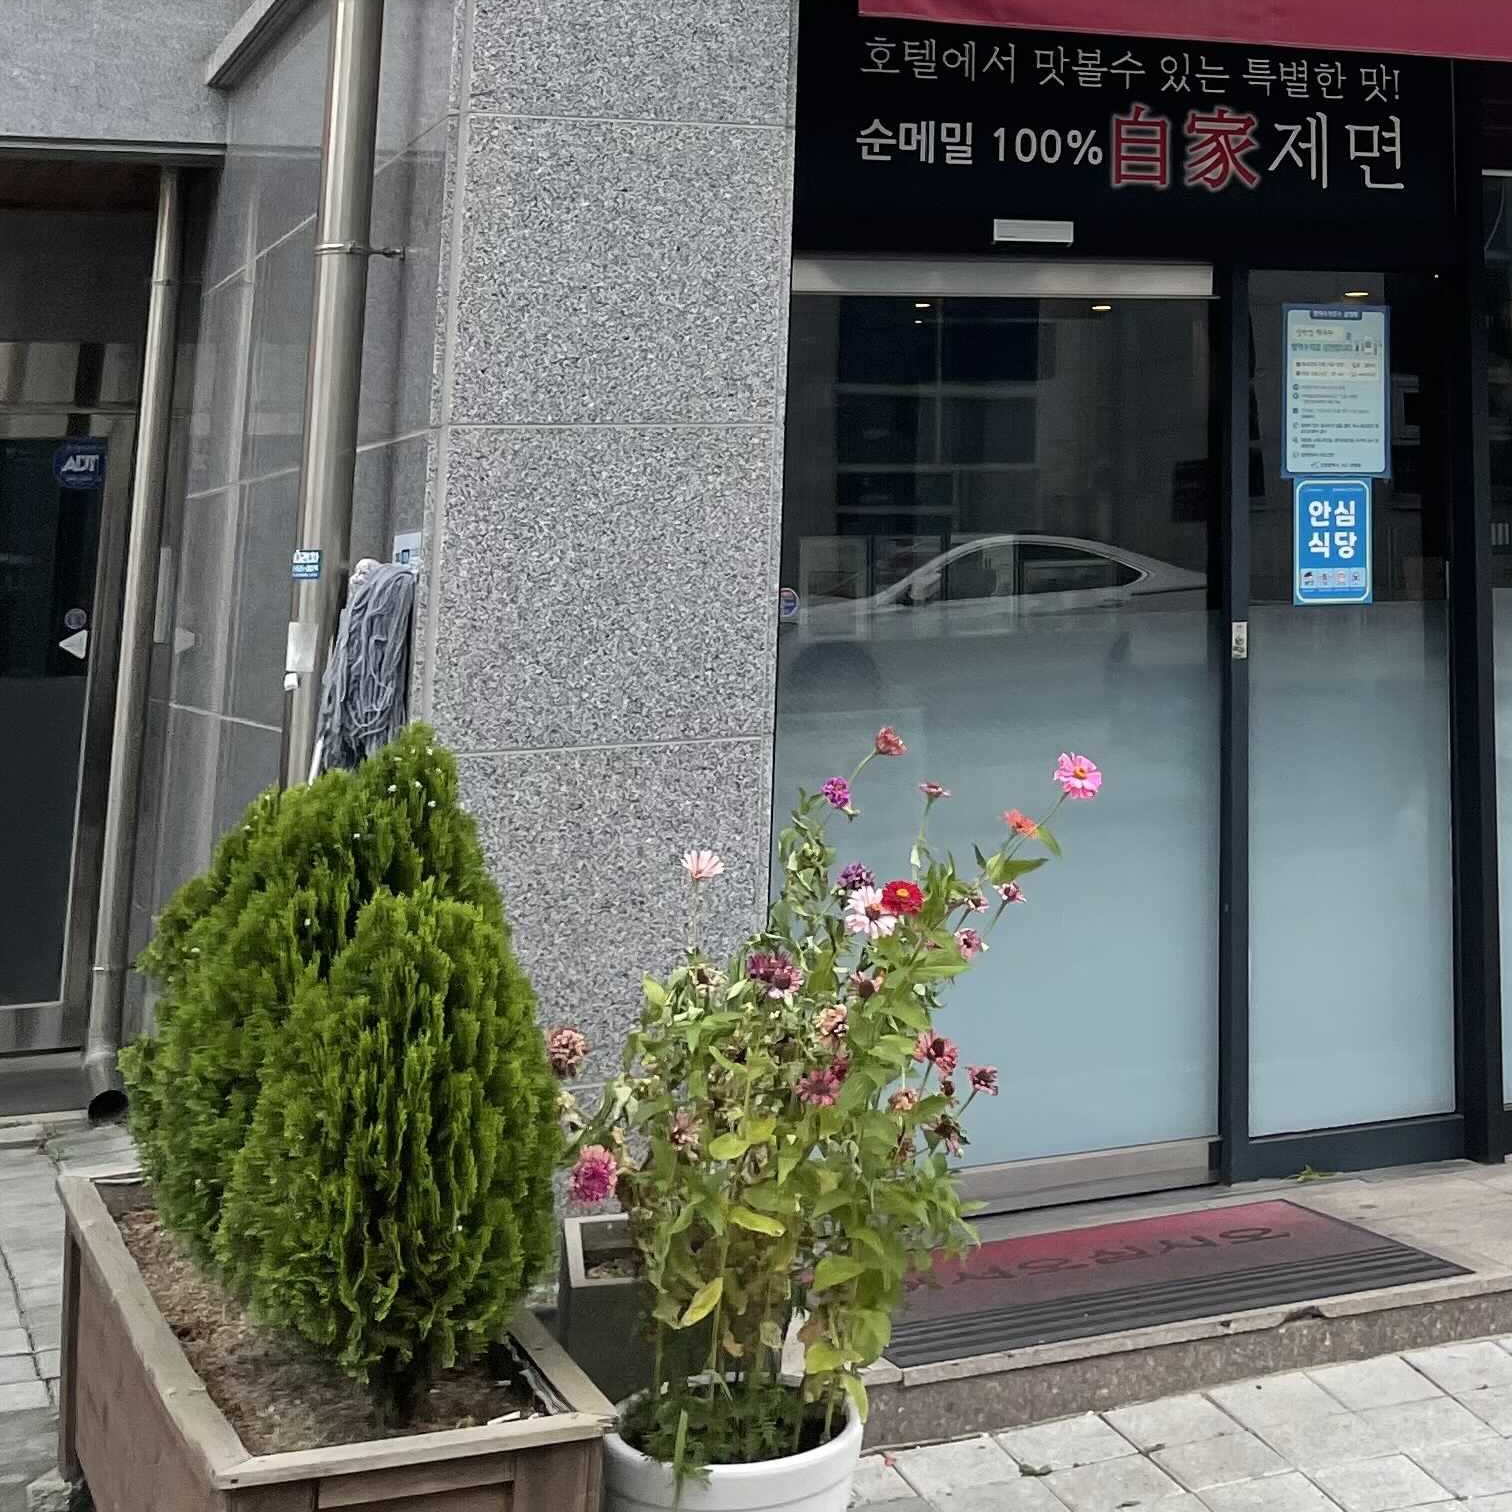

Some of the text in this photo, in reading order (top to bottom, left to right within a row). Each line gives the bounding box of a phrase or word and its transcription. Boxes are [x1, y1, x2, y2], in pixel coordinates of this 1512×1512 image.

[859, 35, 1017, 85] 호텔에서
[1159, 53, 1231, 94] 있는
[1242, 56, 1347, 101] 특별한
[1359, 62, 1401, 104] 맛!
[855, 117, 974, 166] 순메밀
[61, 453, 100, 474] ADT
[1308, 499, 1357, 528] 안심
[1308, 531, 1358, 560] 식당
